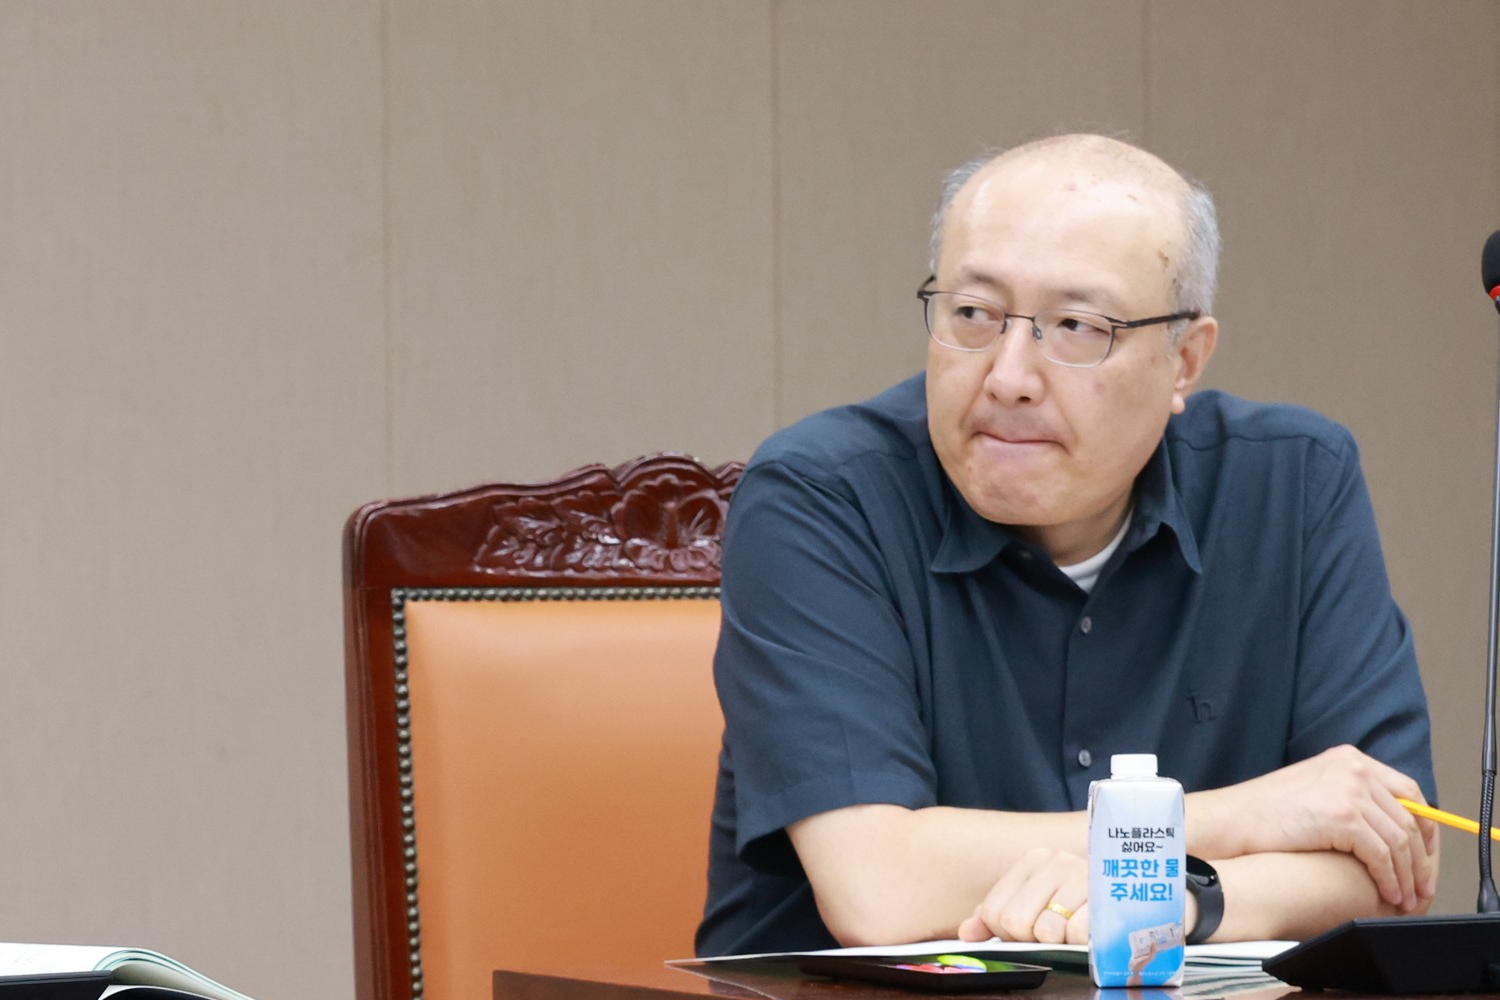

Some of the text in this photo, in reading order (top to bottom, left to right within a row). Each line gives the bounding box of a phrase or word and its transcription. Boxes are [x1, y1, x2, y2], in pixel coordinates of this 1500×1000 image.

[1108, 827, 1175, 840] 나노플라스틱
[1121, 841, 1164, 853] 싫어요~
[1102, 858, 1179, 878] 깨끗한 물
[1110, 882, 1173, 902] 주세요!
